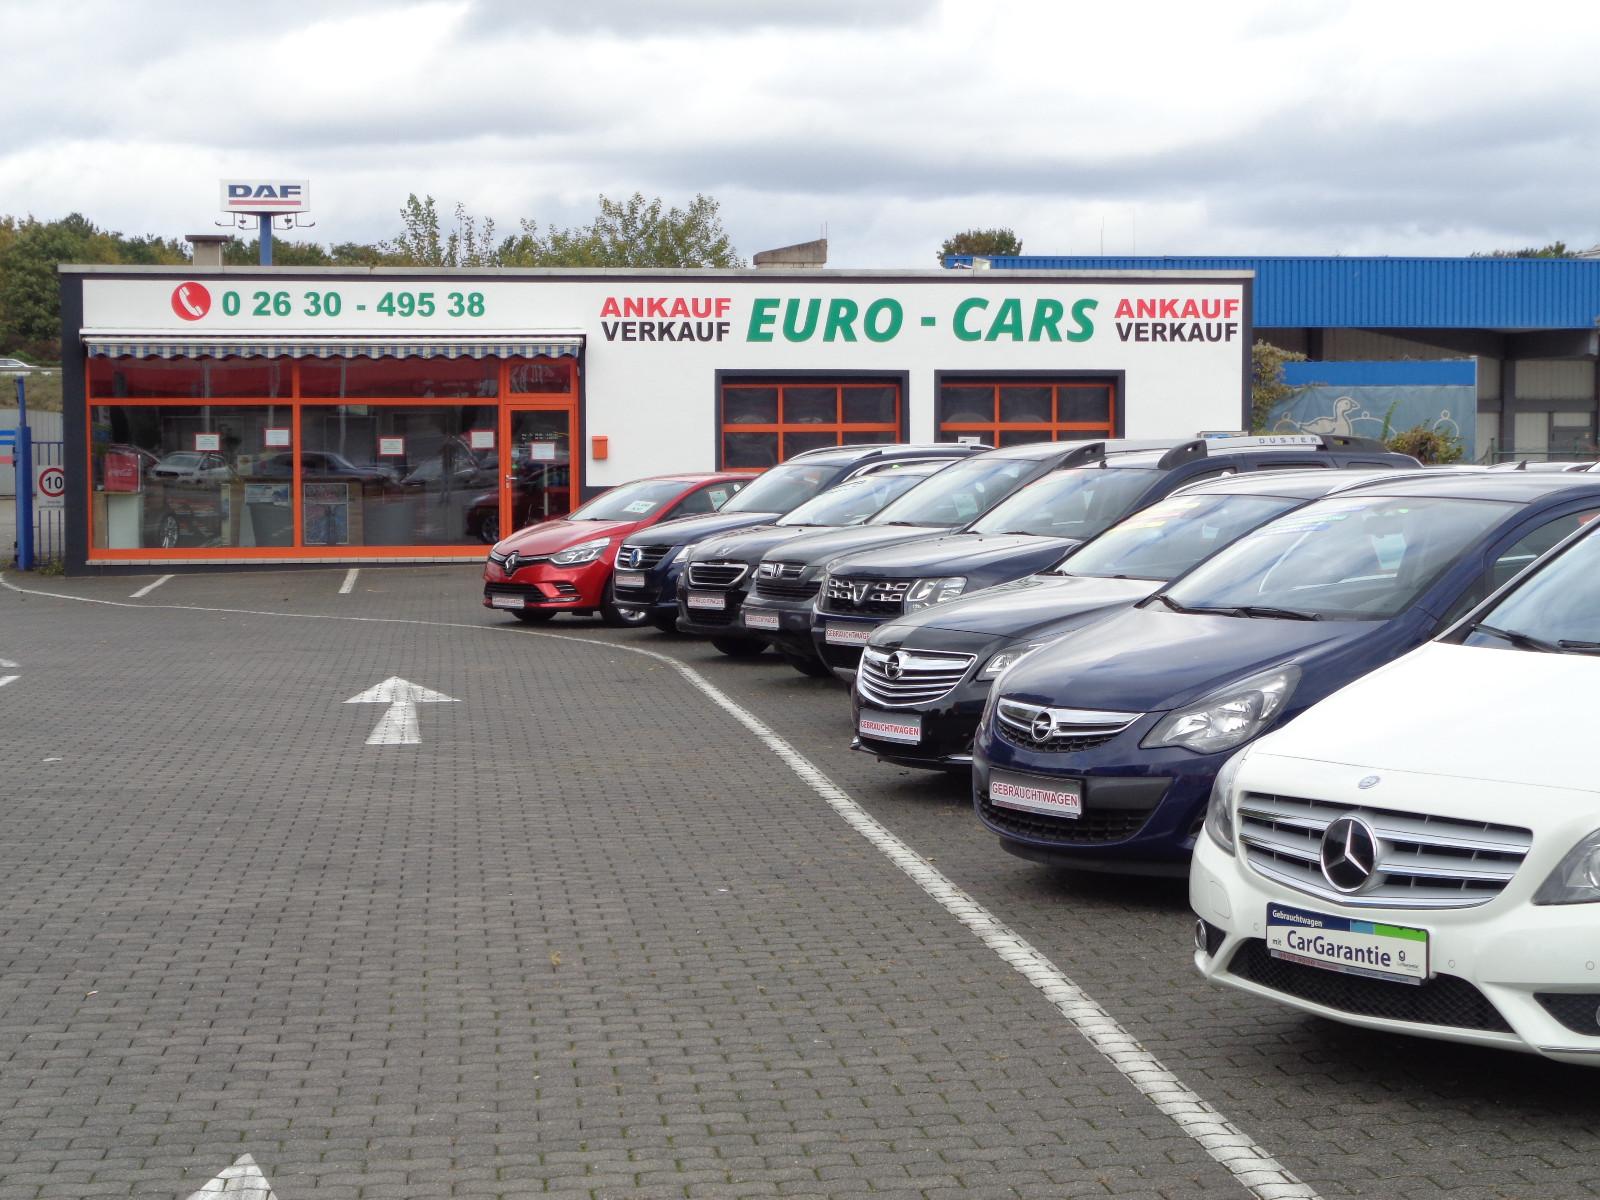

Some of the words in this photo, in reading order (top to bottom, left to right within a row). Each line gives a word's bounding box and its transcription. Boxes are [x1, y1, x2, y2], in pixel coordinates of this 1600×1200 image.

[228, 185, 301, 198] DAF
[222, 291, 241, 316] 0
[252, 291, 291, 316] 26
[303, 291, 341, 316] 30
[376, 291, 435, 317] 495
[447, 292, 485, 317] 38
[600, 297, 731, 318] ANKAUF
[1114, 299, 1239, 318] ANKAUF
[746, 298, 904, 342] EURO
[952, 298, 1098, 342] CARS
[600, 321, 730, 341] VERKAUF
[1115, 323, 1238, 342] VERKAUF
[1258, 436, 1318, 444] DUSTER
[45, 476, 63, 490] 10
[825, 629, 872, 640] GEBRAUCHTWAGE
[859, 720, 920, 736] GEBRAUCHTWAGEN
[991, 782, 1079, 807] GEBRAUCHTWAGEN
[1272, 909, 1323, 928] Gebrauchtwagen
[1272, 938, 1282, 947] mit
[1286, 929, 1392, 968] CarGarantie
